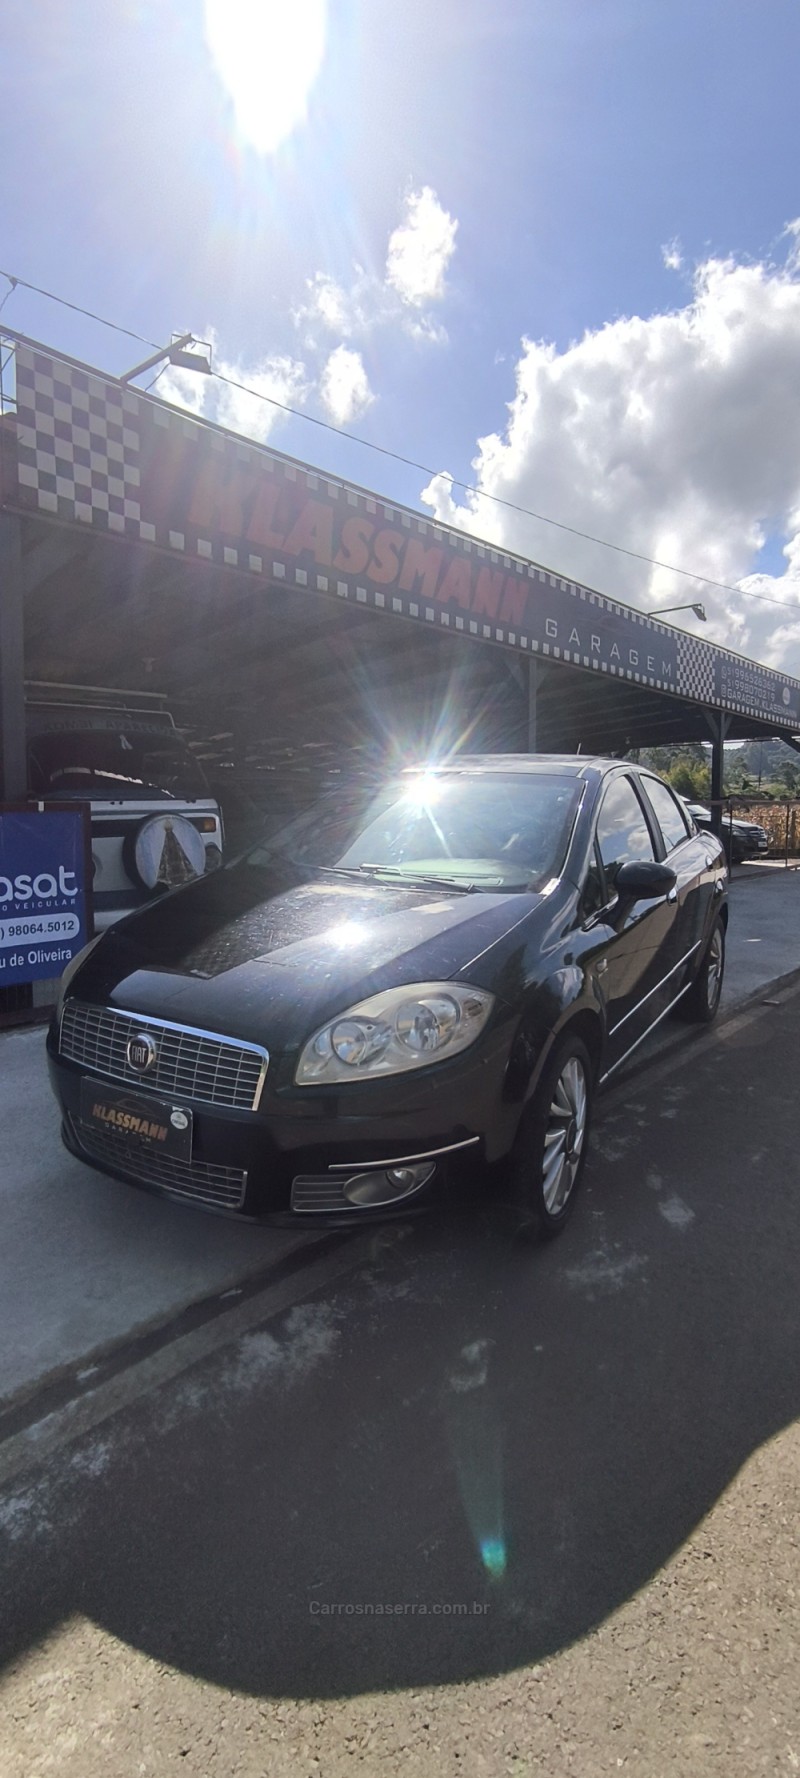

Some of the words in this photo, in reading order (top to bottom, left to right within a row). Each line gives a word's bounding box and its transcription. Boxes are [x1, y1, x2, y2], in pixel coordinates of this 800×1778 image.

[188, 457, 529, 626] KLASSMANN
[545, 618, 672, 677] GARAGEM
[15, 898, 76, 911] VEICULAR
[8, 920, 75, 937] 98064.5012
[9, 953, 25, 967] de
[27, 947, 72, 964] Oliveira
[131, 1045, 147, 1063] FIAT
[92, 1103, 169, 1141] KLASSMANN
